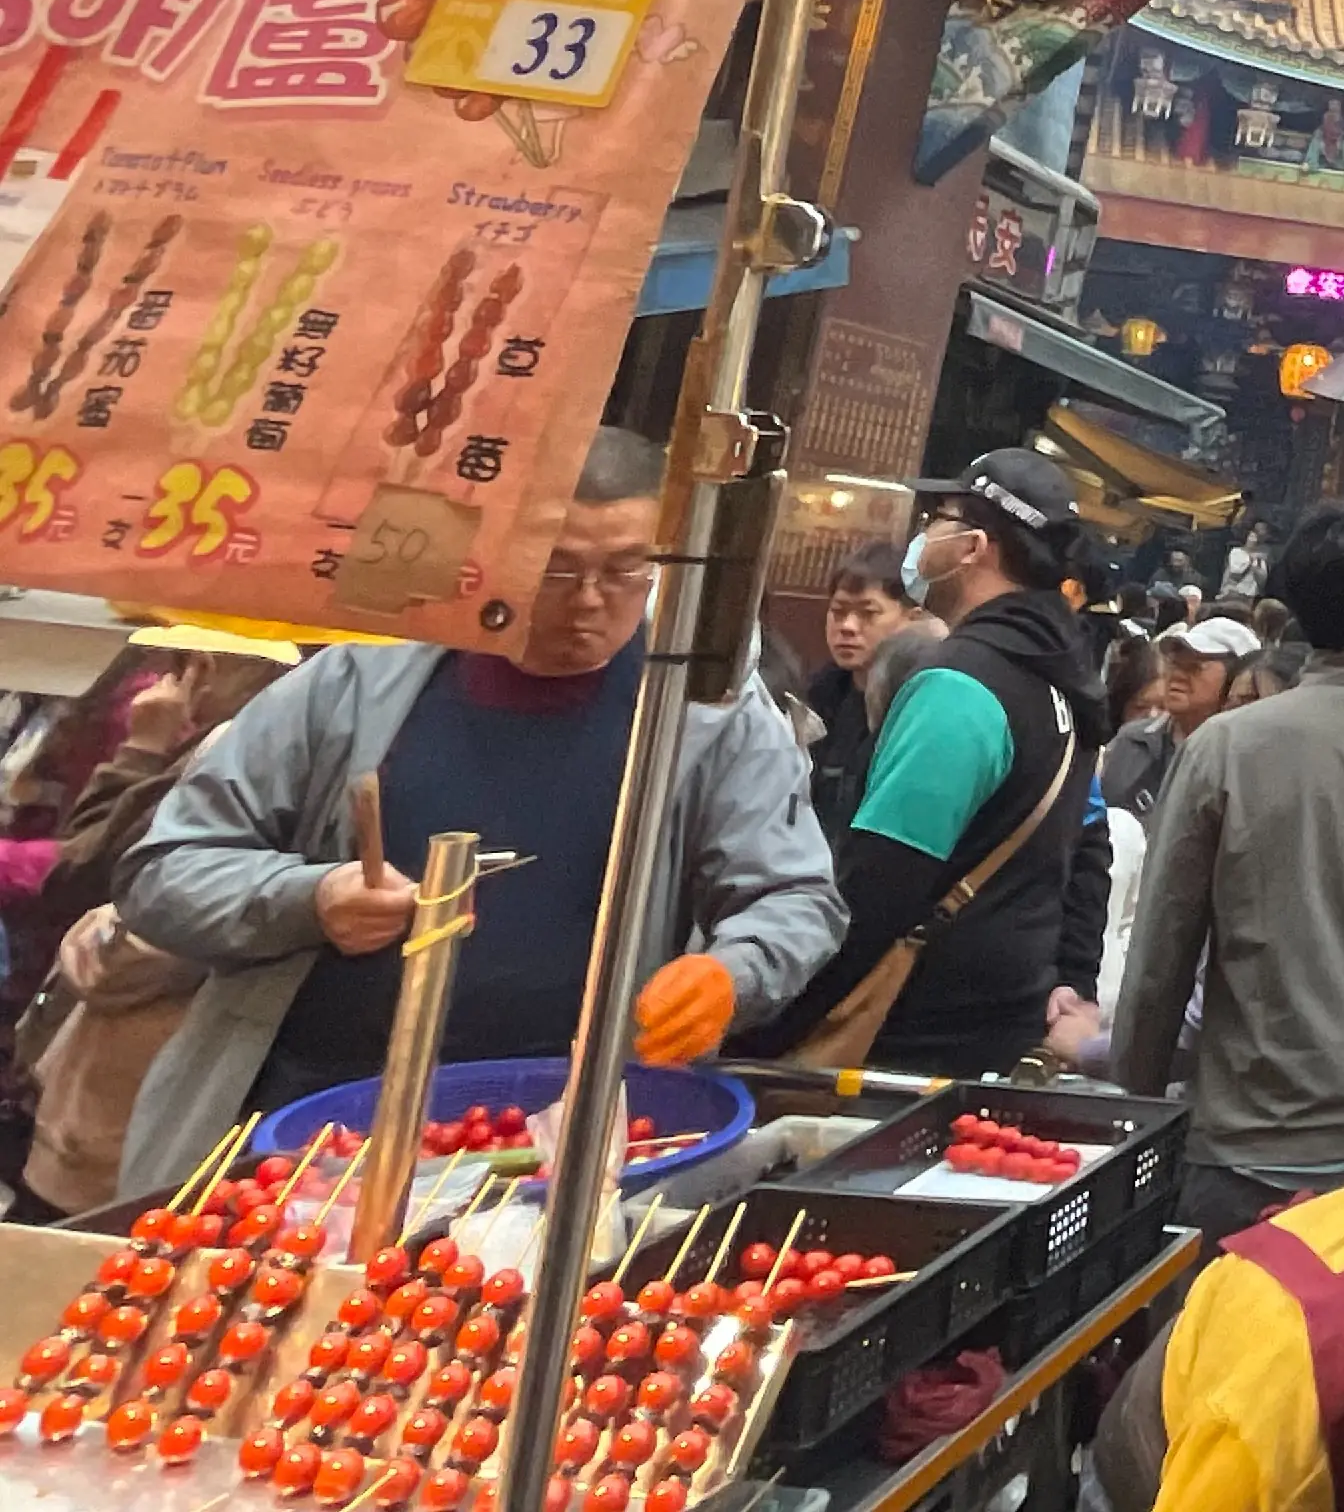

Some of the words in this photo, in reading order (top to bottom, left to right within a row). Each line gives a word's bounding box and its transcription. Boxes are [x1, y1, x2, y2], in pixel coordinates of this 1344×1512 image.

[512, 12, 596, 80] 33
[245, 308, 341, 453] 無籽葡萄
[456, 334, 547, 484] 草莓
[354, 516, 433, 566] 50
